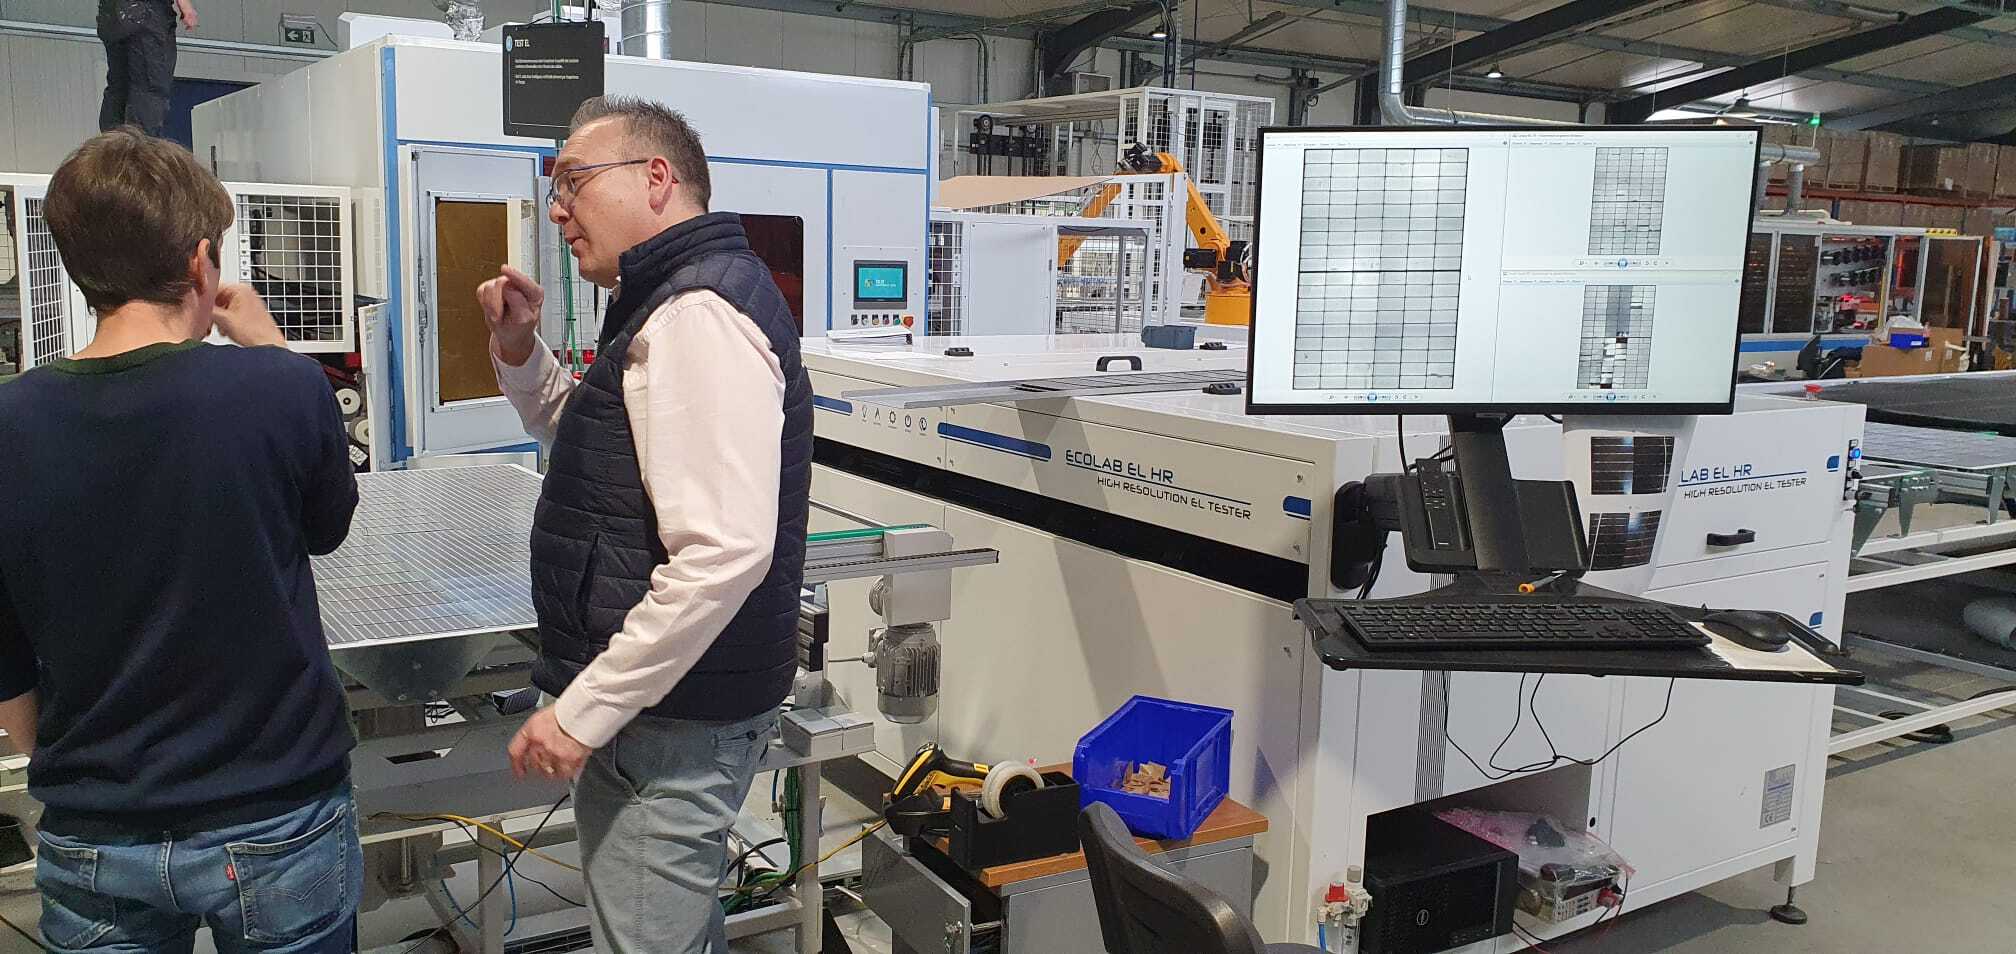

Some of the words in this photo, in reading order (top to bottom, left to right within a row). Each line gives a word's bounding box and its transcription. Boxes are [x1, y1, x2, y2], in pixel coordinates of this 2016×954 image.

[514, 39, 524, 47] TEST
[1065, 450, 1123, 473] ECOLAB
[1127, 463, 1146, 478] EL
[1150, 467, 1174, 484] HR
[1713, 465, 1729, 480] EL
[1733, 464, 1753, 477] HR
[1097, 476, 1121, 490] HIGH
[1123, 481, 1188, 505] RESOLUTION
[1190, 497, 1205, 510] EL
[1208, 501, 1251, 520] TESTER
[1684, 488, 1706, 499] HIGH
[1708, 482, 1762, 496] RESOLUTION
[1764, 481, 1775, 490] EL
[1777, 478, 1807, 489] TESTER
